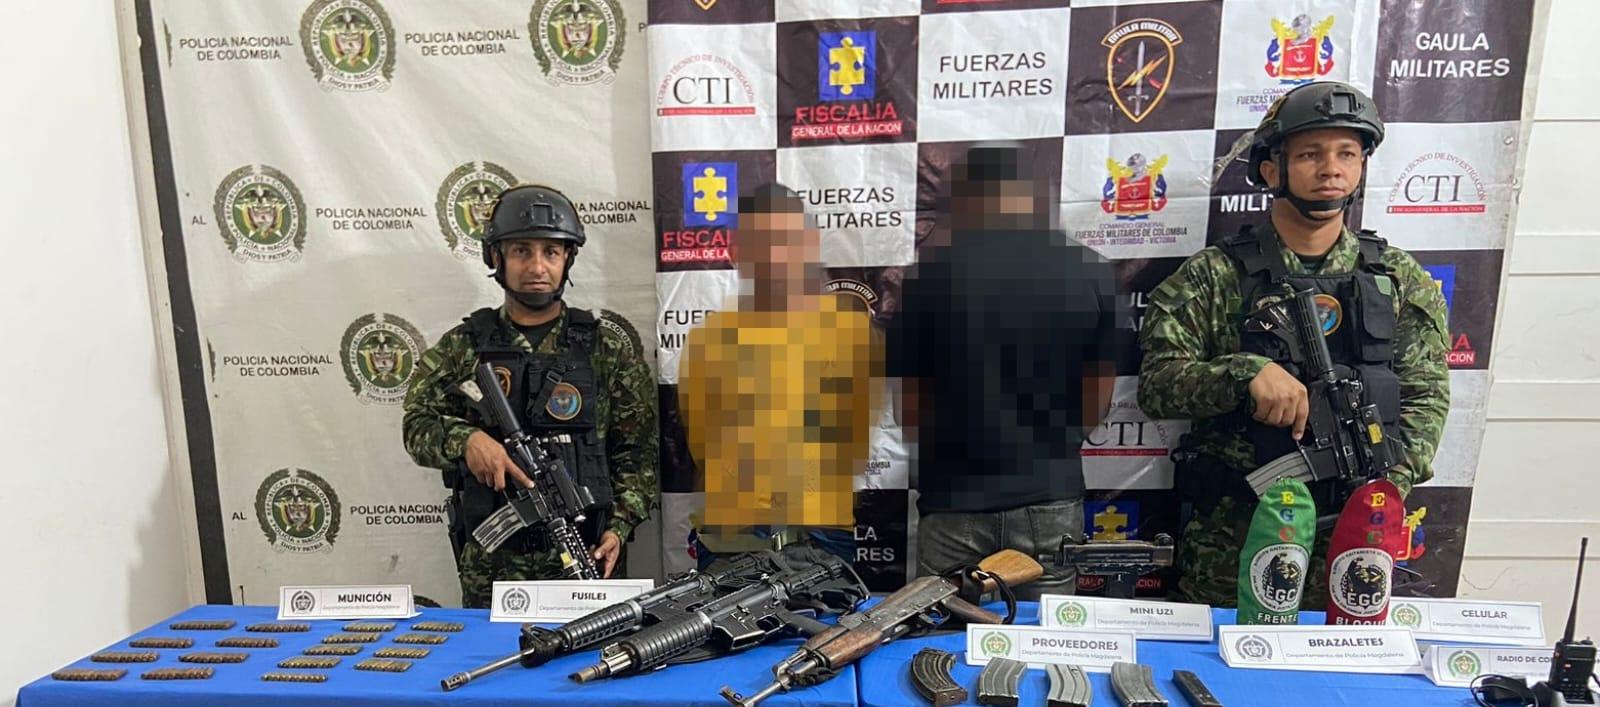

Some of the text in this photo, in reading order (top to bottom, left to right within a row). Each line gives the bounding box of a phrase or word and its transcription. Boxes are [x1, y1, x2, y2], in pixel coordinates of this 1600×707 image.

[180, 35, 294, 49] POLICIA NACIONAL
[405, 29, 521, 43] POLICIA NACIONAL
[1416, 32, 1489, 51] GAULA
[197, 49, 281, 61] DE COLOMBIA
[422, 44, 506, 56] DE COLOMBIA
[940, 52, 1046, 72] FUERZAS
[1390, 58, 1510, 78] MILITARES
[673, 76, 733, 104] CTI
[933, 78, 1053, 99] MILITARES
[796, 102, 897, 123] FISCALIA
[792, 126, 835, 137] GENERAL
[836, 125, 850, 135] DE
[851, 124, 865, 134] LA
[1404, 174, 1463, 202] CTI
[316, 207, 427, 218] POLICIA NACIONAL
[589, 201, 651, 212] NACIONAL
[333, 219, 414, 230] DE COLOMBIA
[580, 213, 637, 224] OLOMBIA
[815, 211, 902, 229] LITARES
[1106, 229, 1141, 238] MILITARES
[1142, 229, 1152, 237] DE
[661, 249, 731, 262] GENERAL DE LA
[224, 354, 334, 365] POLICIA NACIONAL
[240, 367, 320, 376] DE COLOMBIA
[350, 504, 449, 515] POLICIA NACIONA
[366, 515, 444, 526] DE COLOMBIA
[854, 548, 895, 562] RES
[338, 591, 392, 603] MUNICIÓN
[572, 592, 607, 600] FUSILES
[1266, 585, 1296, 601] EGC
[1347, 592, 1382, 607] EGC
[1130, 607, 1154, 615] MINI
[1461, 609, 1508, 619] CELULAR
[1032, 638, 1118, 650] PROVEEDORES
[1308, 638, 1384, 647] BRAZALETES
[1497, 655, 1523, 664] RADIO
